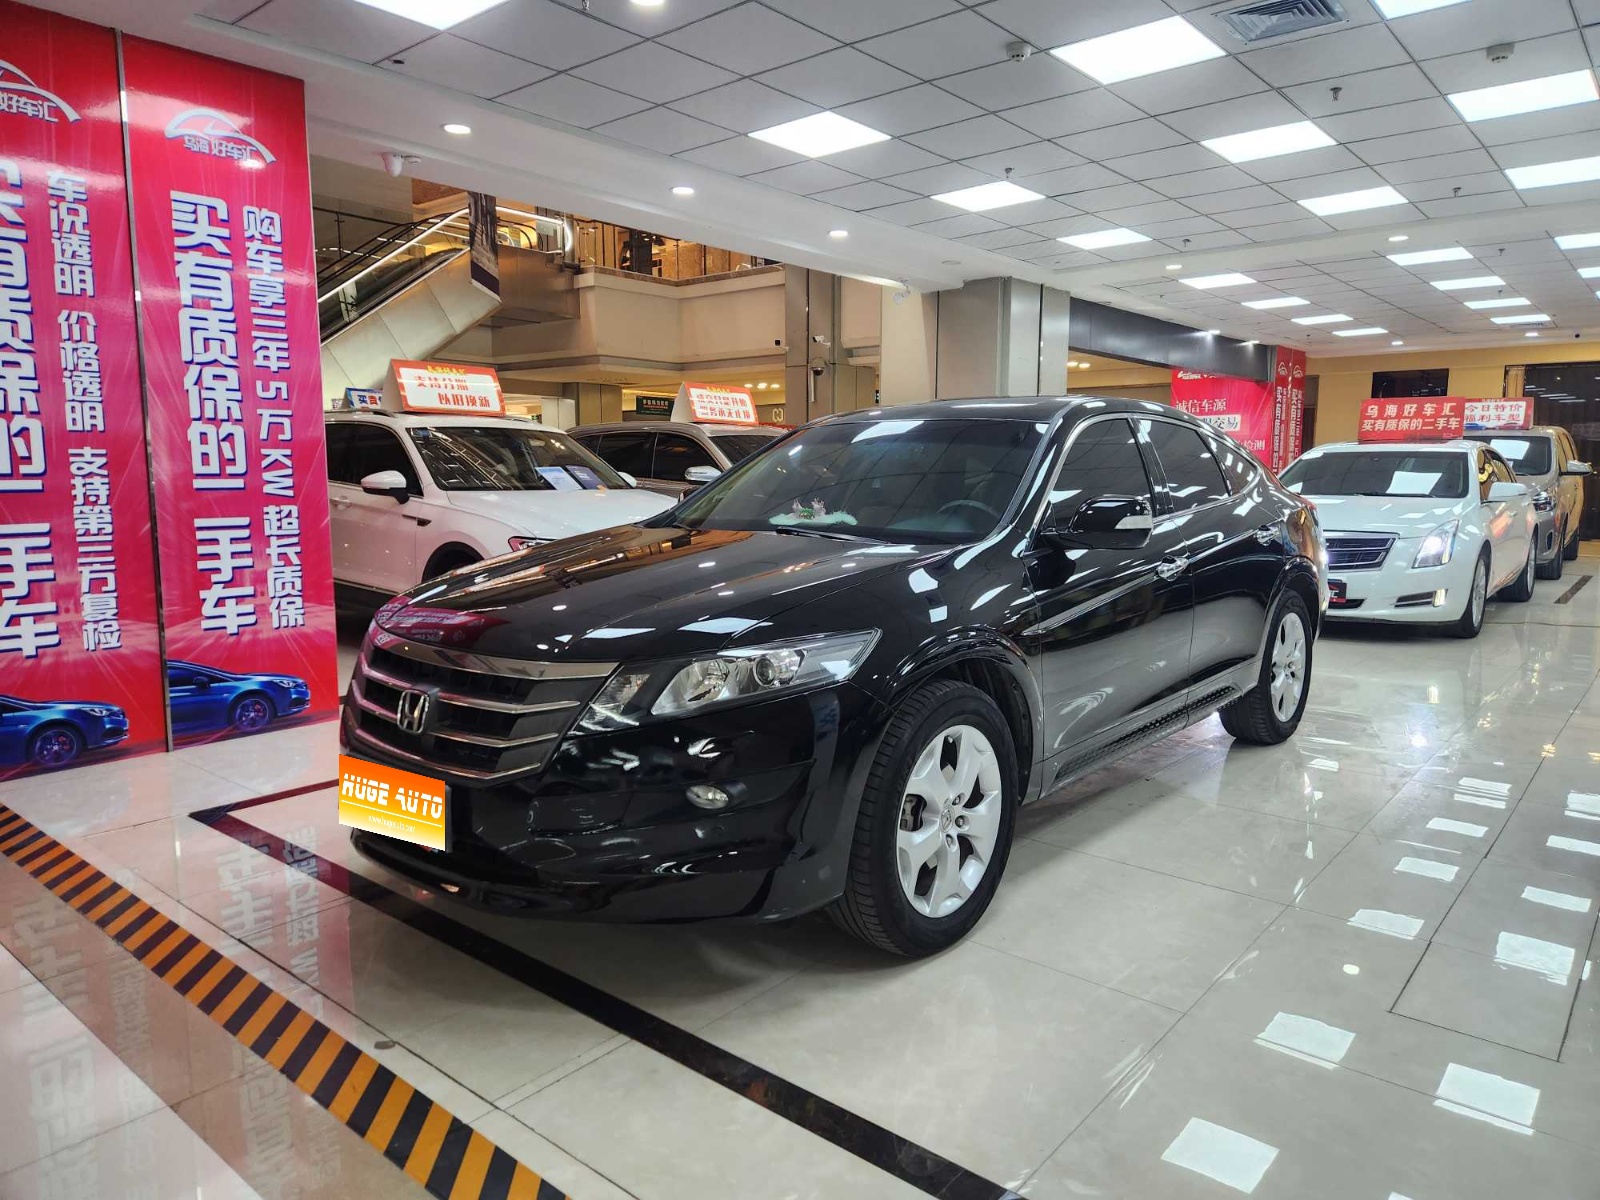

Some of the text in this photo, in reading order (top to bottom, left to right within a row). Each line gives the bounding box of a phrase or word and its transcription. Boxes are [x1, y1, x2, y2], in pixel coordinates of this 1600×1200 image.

[437, 393, 491, 408] 以旧换新
[1465, 403, 1524, 412] 今日特价
[47, 169, 122, 651] 车况透明 价格透明 支持第三方复检
[170, 189, 258, 637] 买有质保的二手车
[1365, 402, 1457, 417] 乌海好车汇
[1203, 416, 1239, 430] 交易
[1361, 417, 1461, 432] 买有质保的二手车
[1465, 413, 1521, 423] 福利车型
[1239, 439, 1266, 451] 检测
